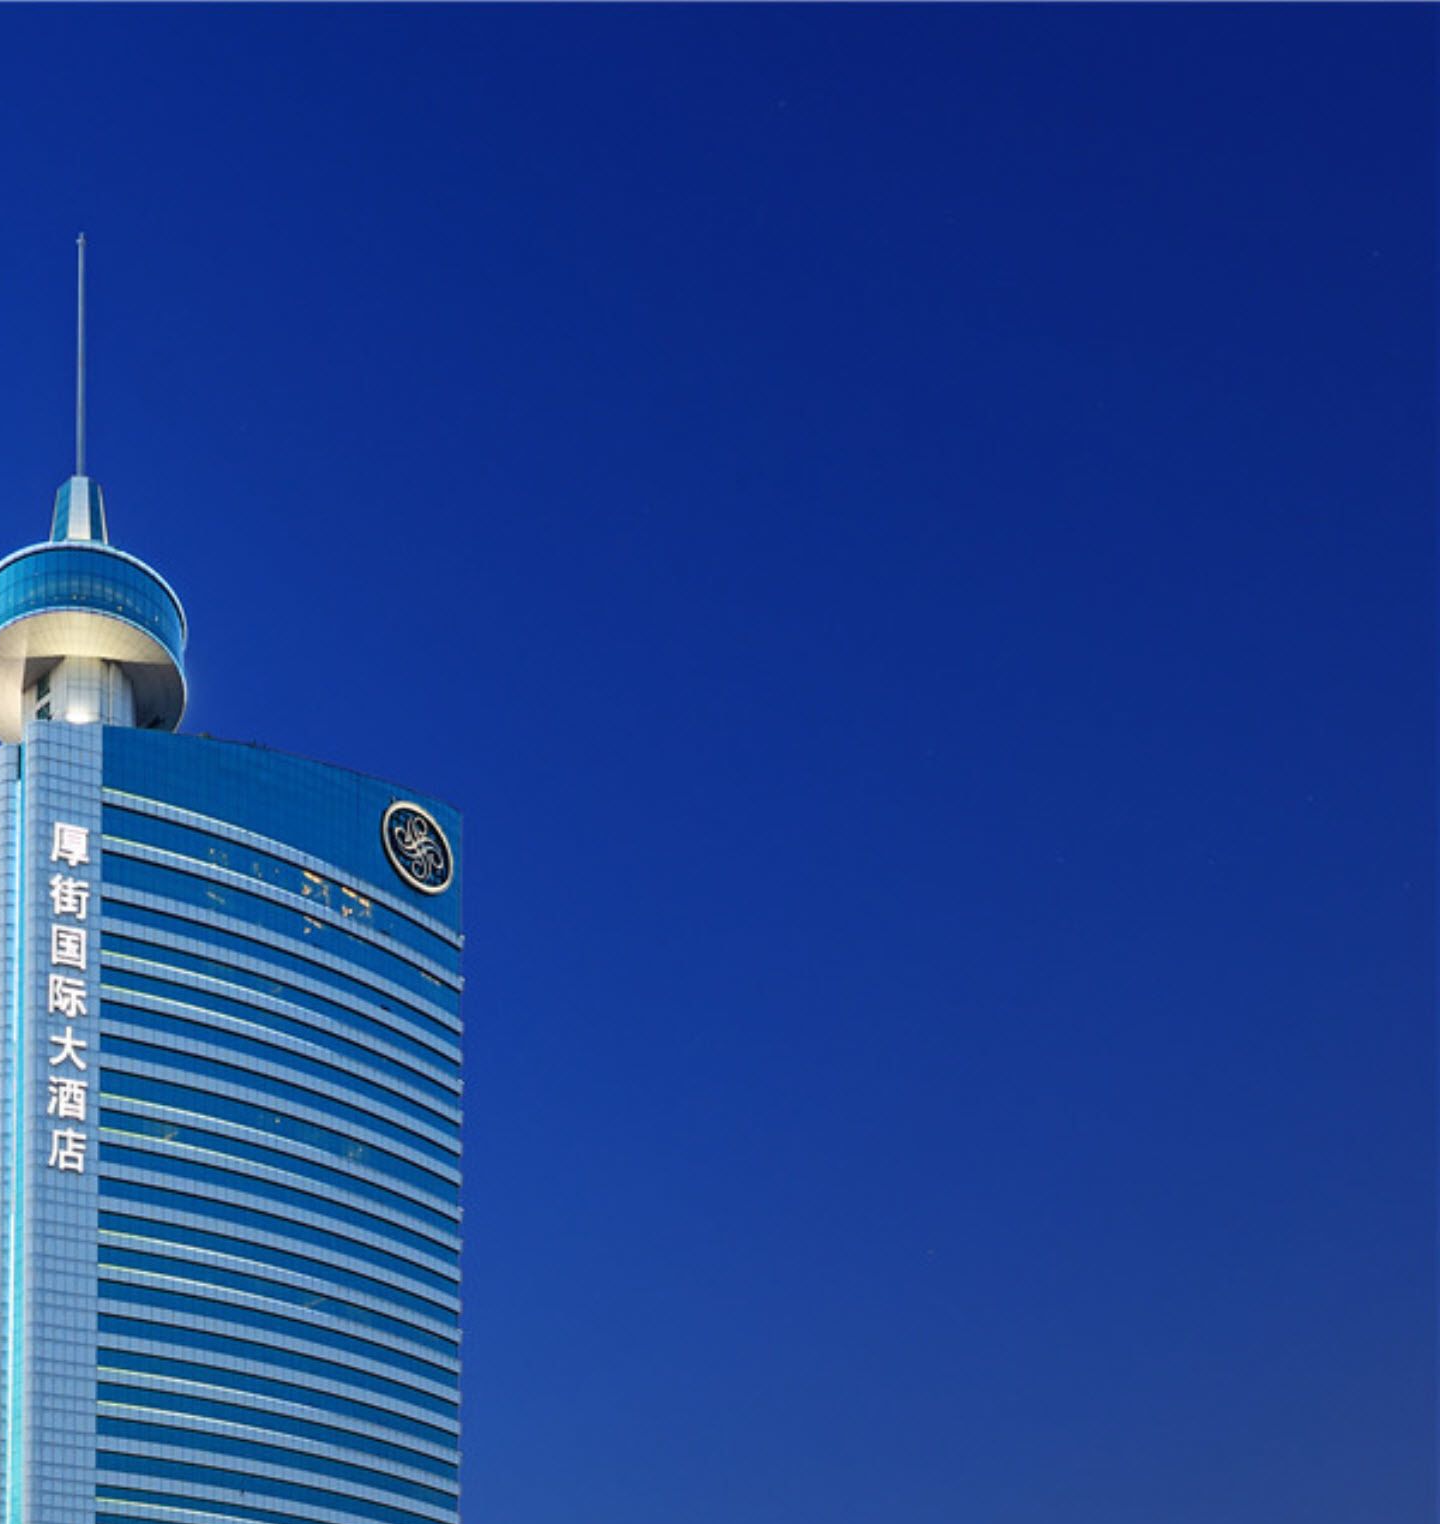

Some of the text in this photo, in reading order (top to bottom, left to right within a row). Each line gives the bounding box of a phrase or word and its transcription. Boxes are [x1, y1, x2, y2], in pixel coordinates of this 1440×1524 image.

[47, 821, 90, 1174] 厚街国际大酒店
